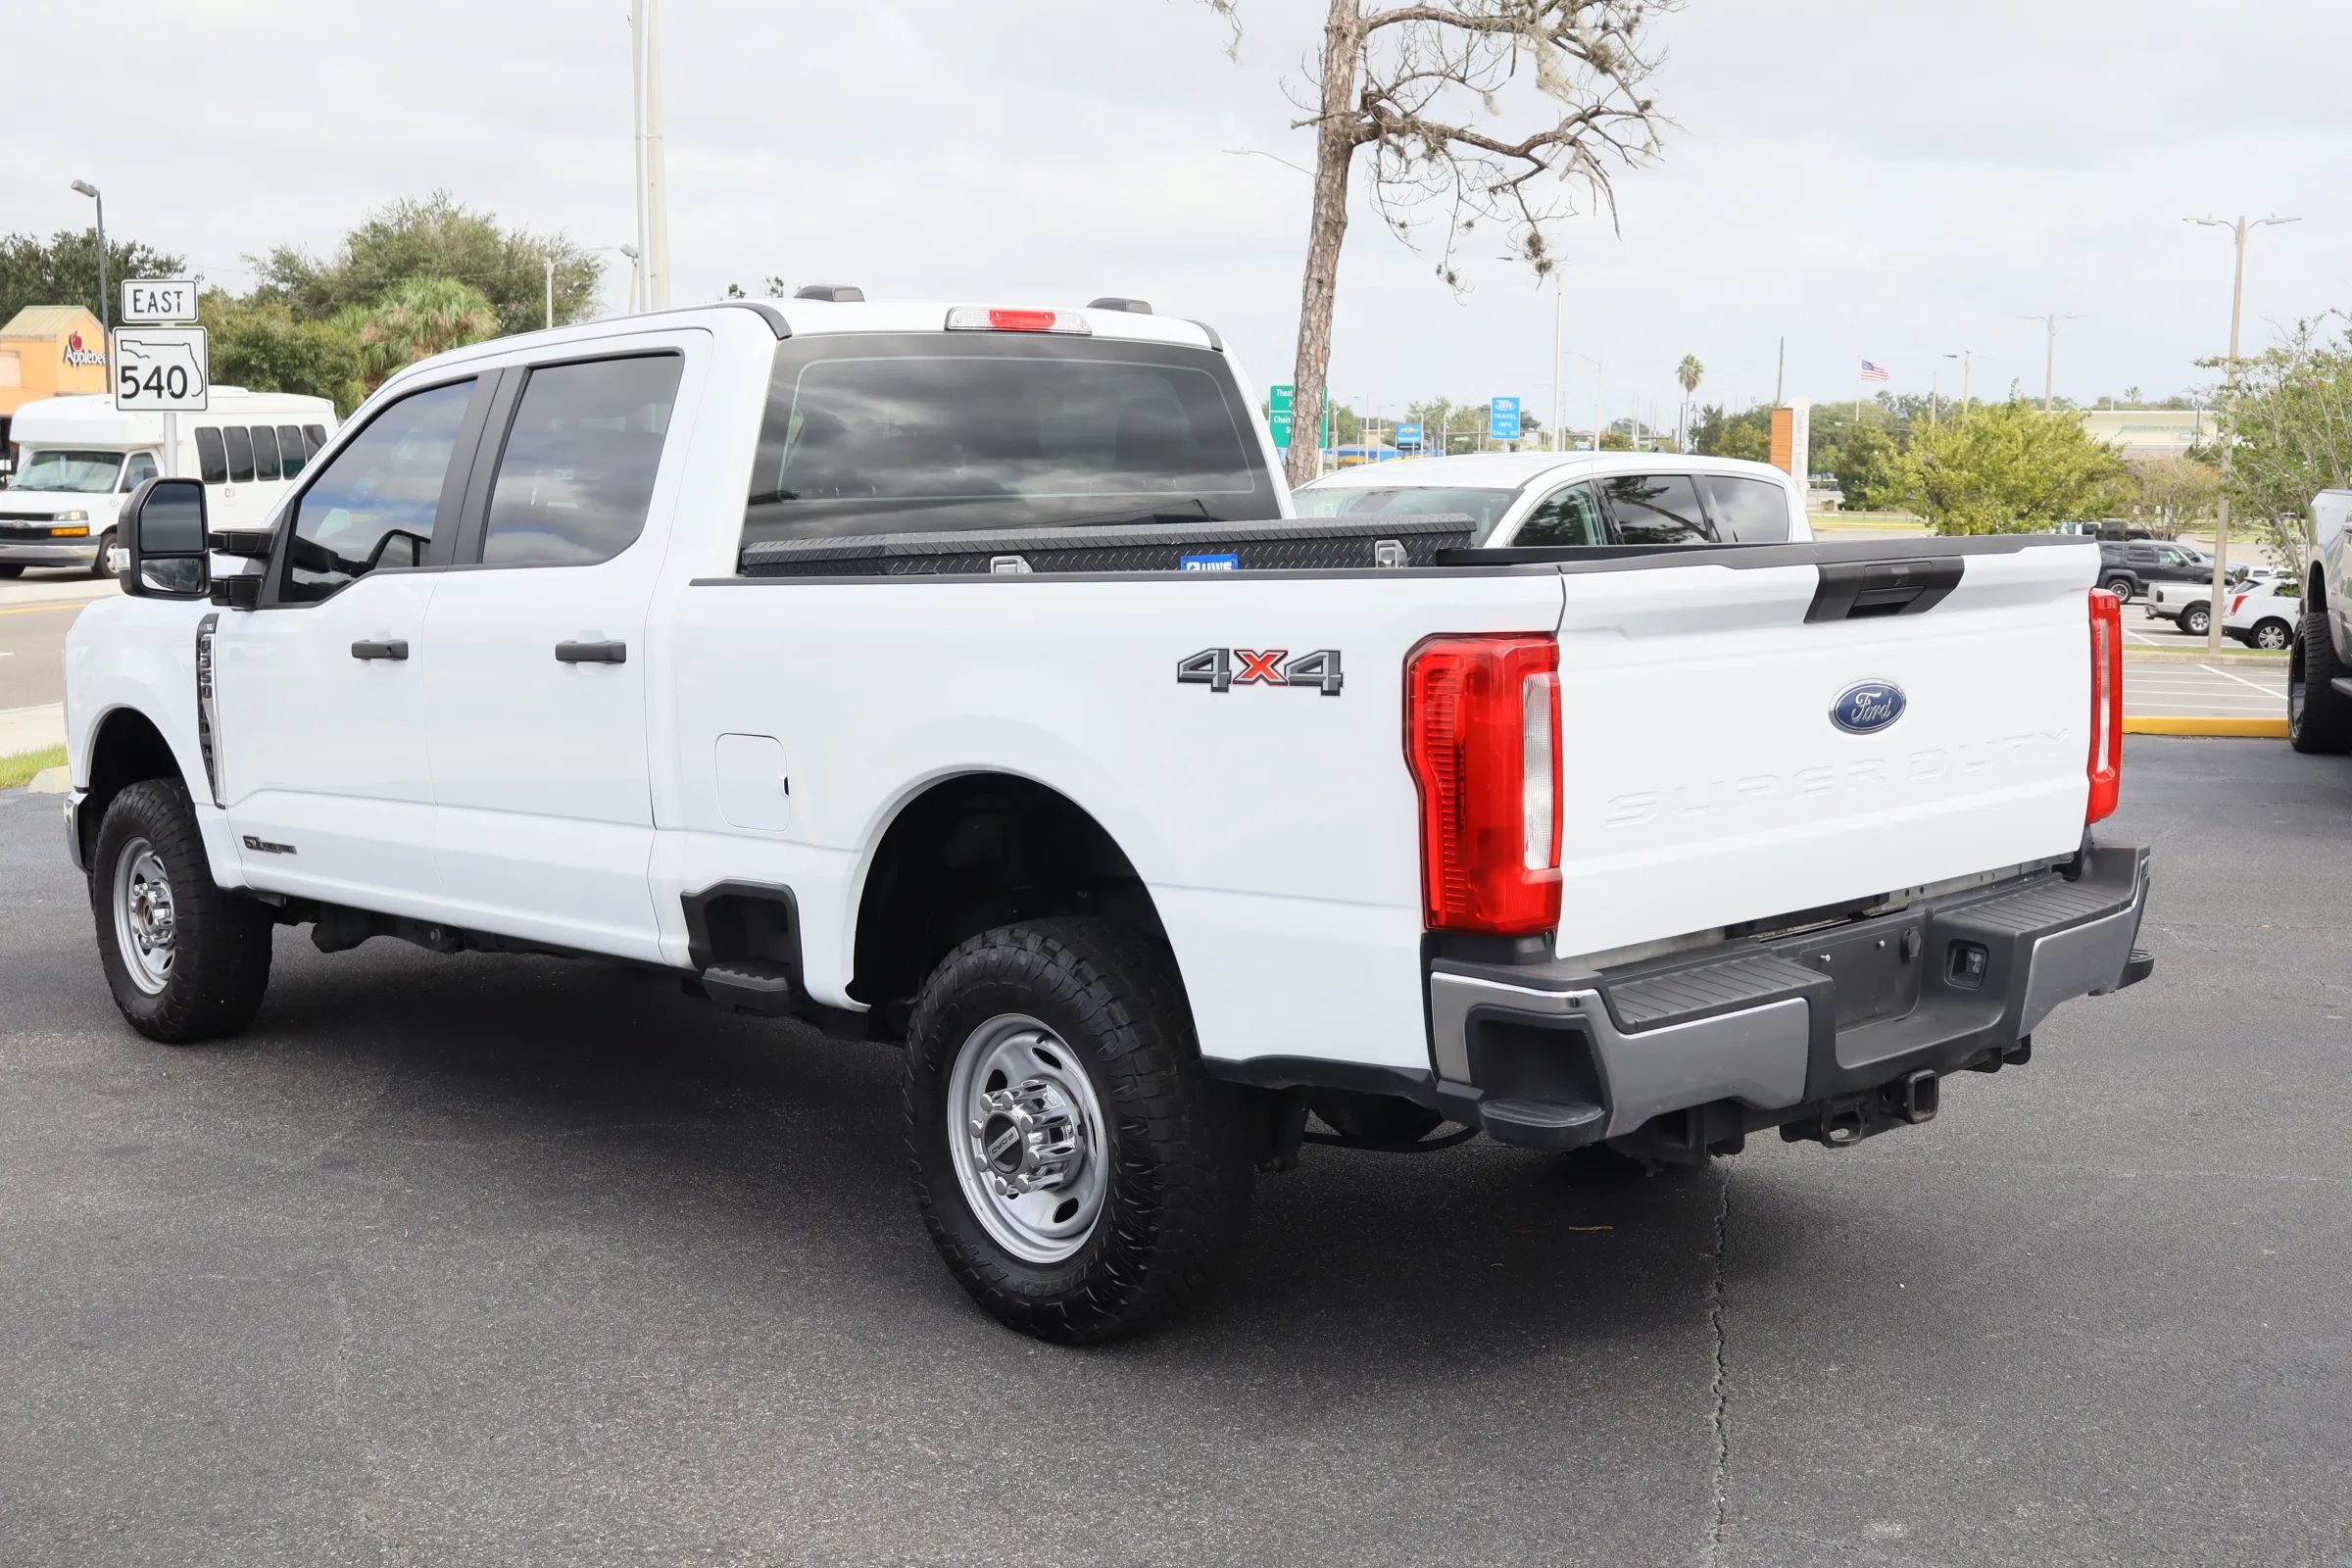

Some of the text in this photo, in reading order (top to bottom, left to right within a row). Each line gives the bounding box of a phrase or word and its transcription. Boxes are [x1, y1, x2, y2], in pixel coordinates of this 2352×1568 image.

[132, 288, 183, 314] EAST
[66, 344, 107, 368] Applebee
[121, 365, 188, 400] 540
[1851, 691, 1891, 724] Ford
[1605, 727, 2070, 829] SUPER DUTY
[991, 1132, 1014, 1154] FORD
